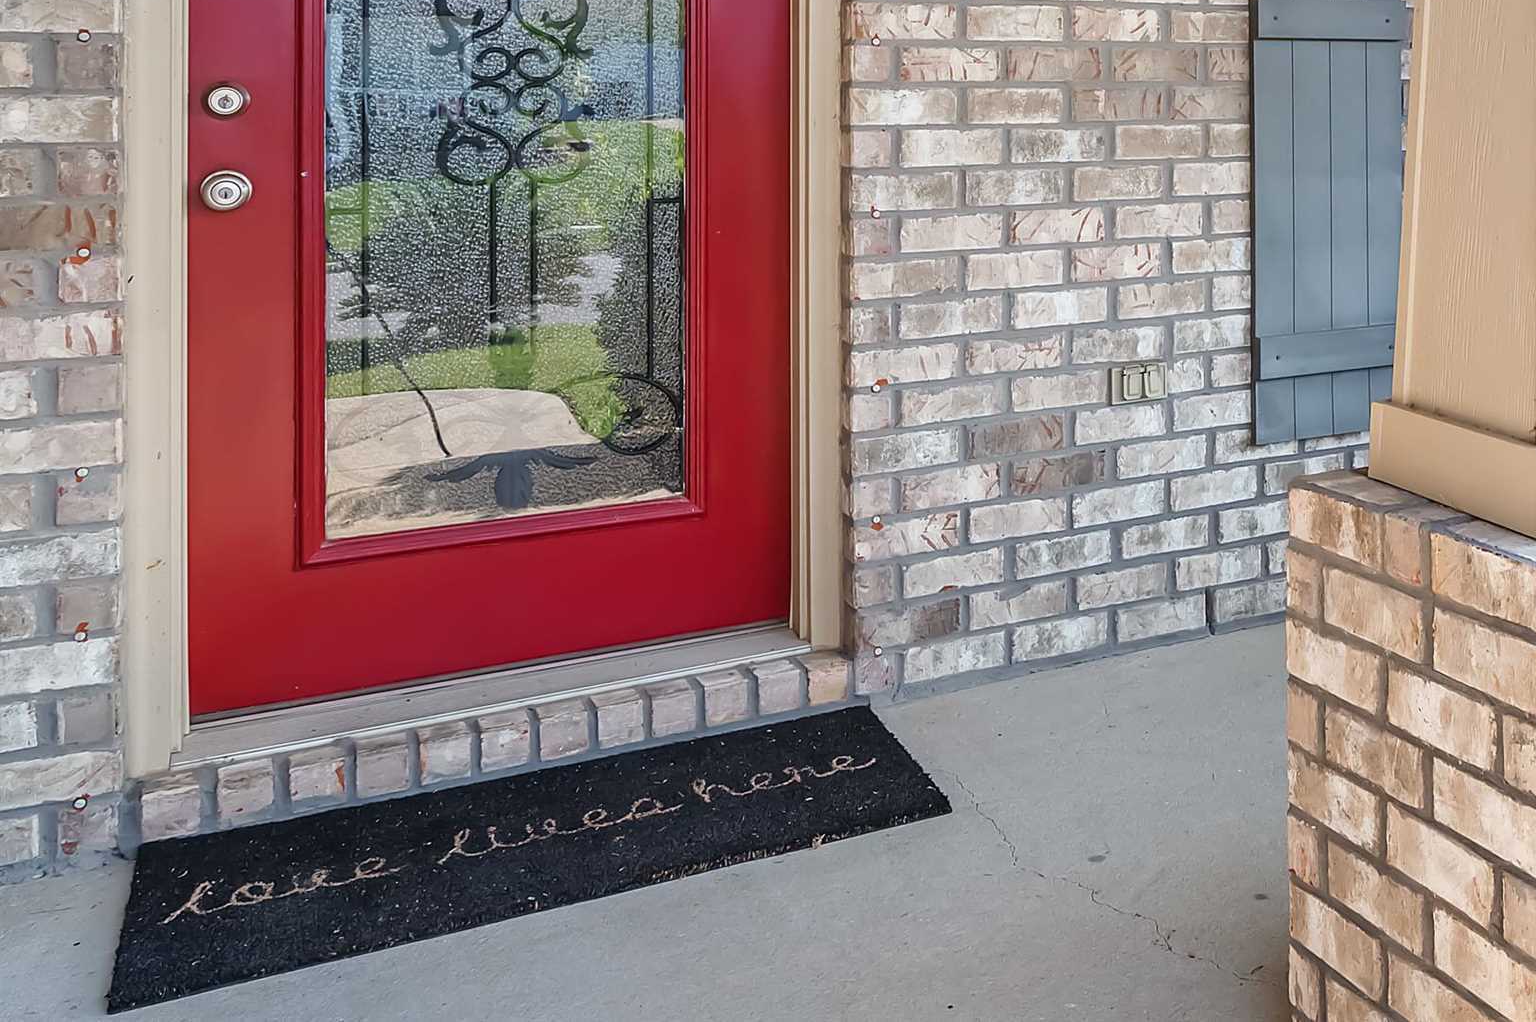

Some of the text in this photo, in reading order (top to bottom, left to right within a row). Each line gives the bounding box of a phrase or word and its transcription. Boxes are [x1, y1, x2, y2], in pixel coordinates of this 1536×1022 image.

[158, 755, 877, 925] love lives here
